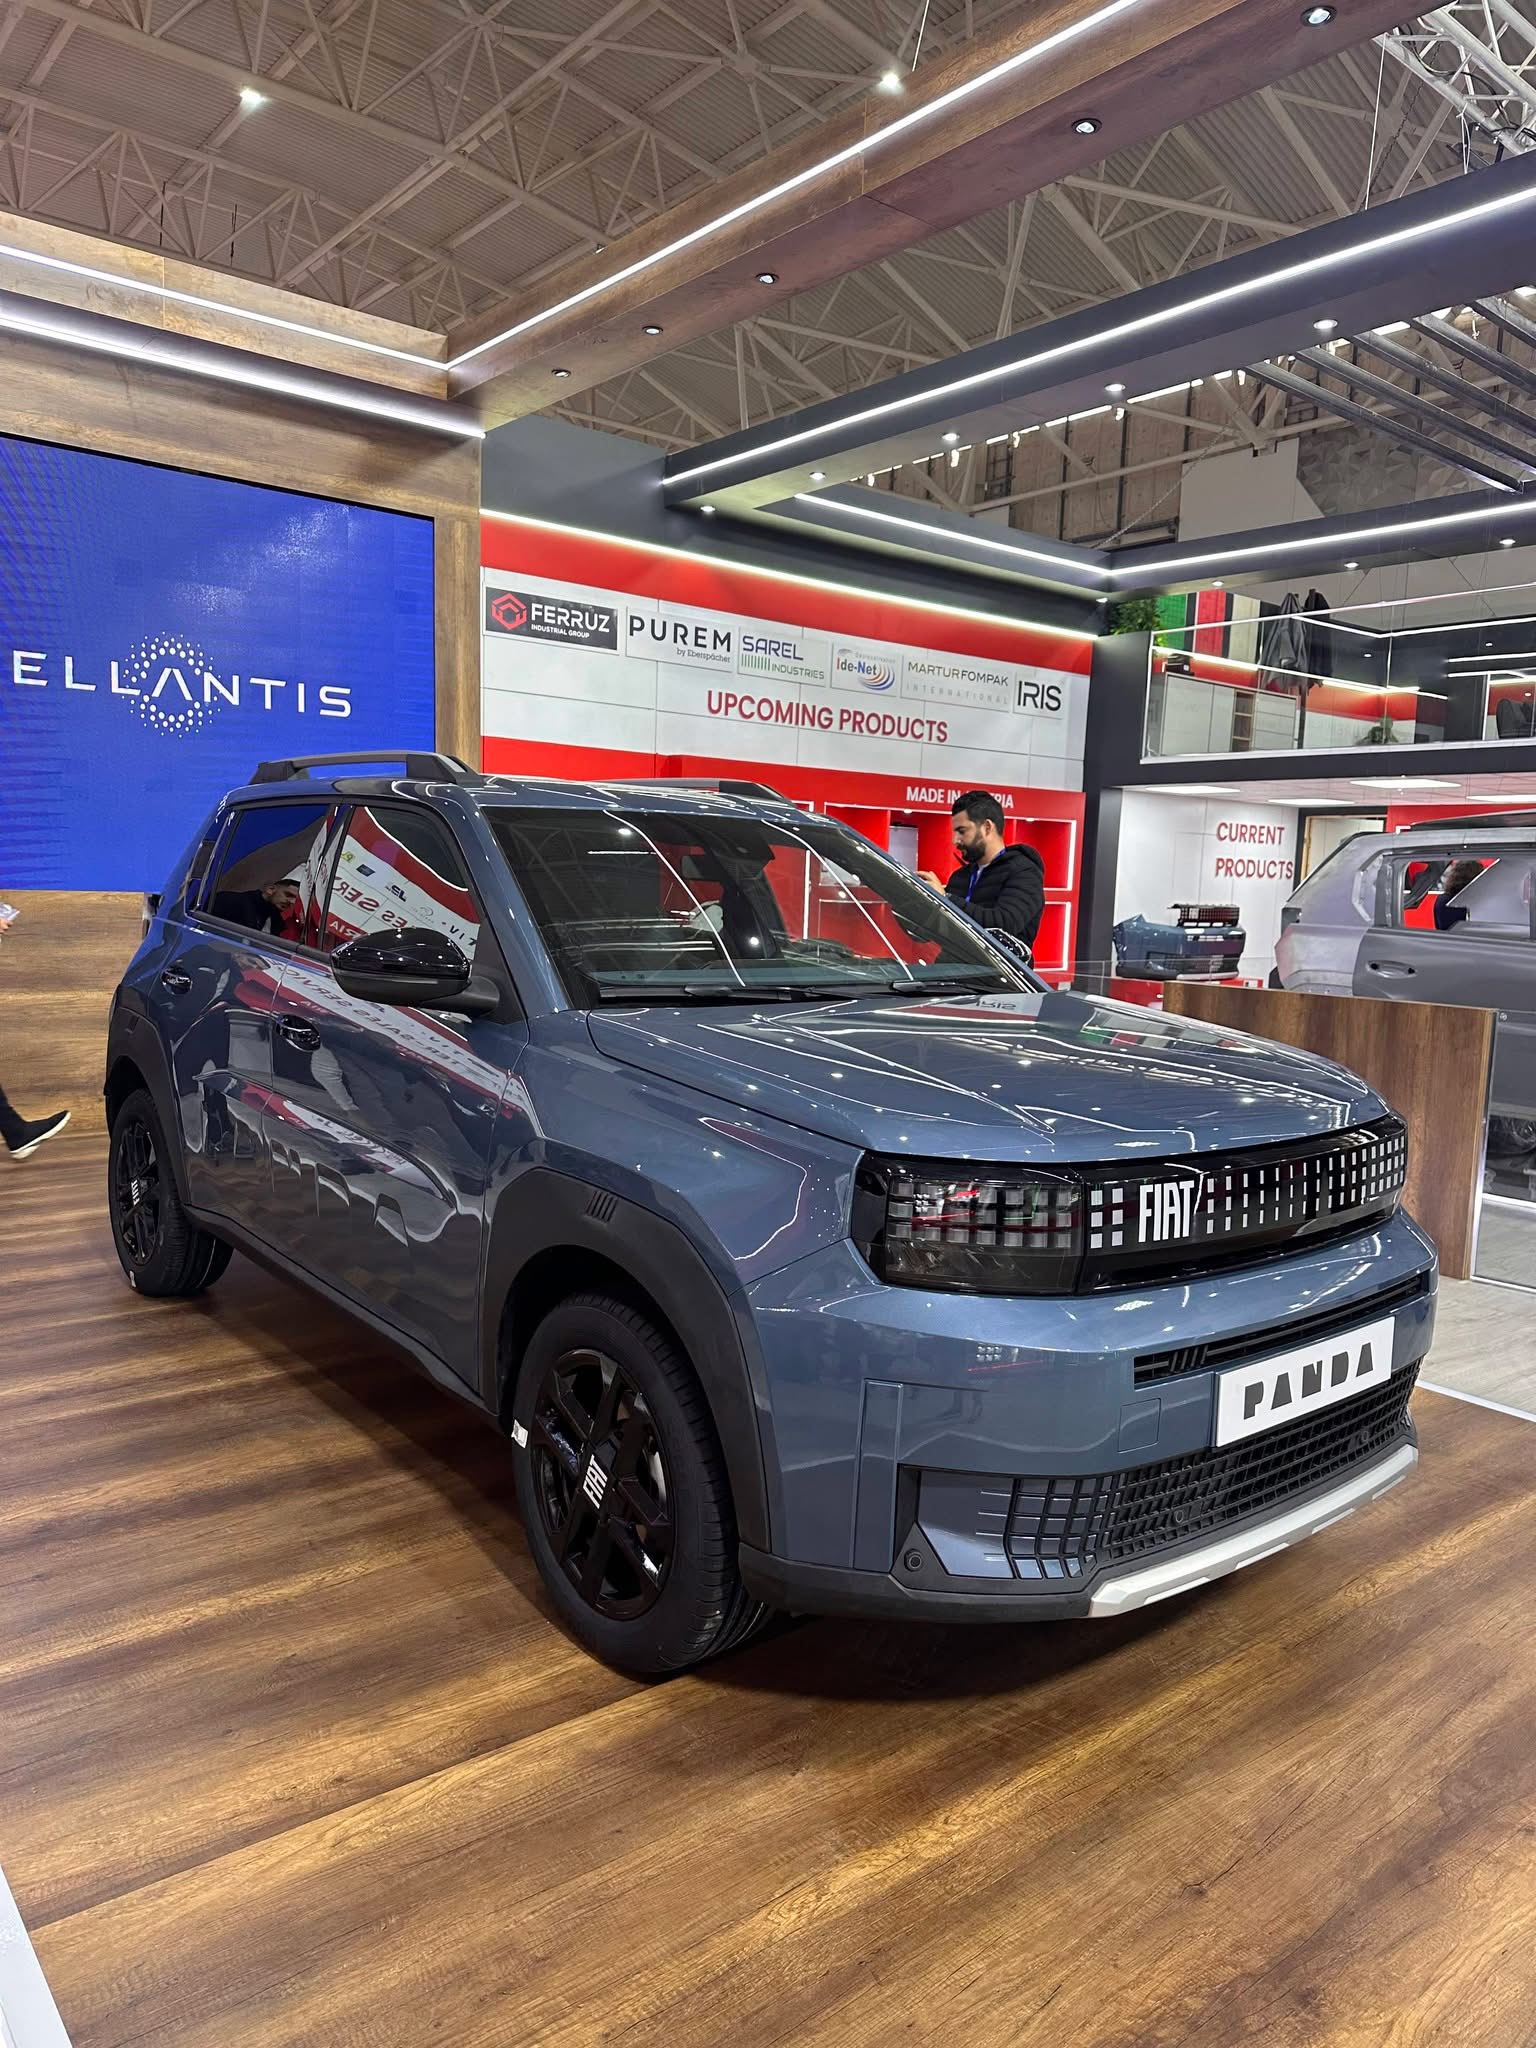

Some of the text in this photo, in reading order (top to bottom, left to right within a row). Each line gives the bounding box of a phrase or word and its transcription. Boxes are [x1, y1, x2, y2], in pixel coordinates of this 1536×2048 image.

[531, 602, 610, 633] FERRUZ
[531, 624, 590, 639] INDUSTRIAL GROUP
[629, 615, 732, 653] PUREM
[677, 648, 686, 657] by
[742, 635, 804, 661] SAREL
[772, 663, 825, 680] INDUSTRIES
[837, 657, 878, 676] Ide-Net
[1017, 680, 1062, 711] IRIS
[707, 690, 948, 743] UPCOMING PRODUCTS
[906, 786, 945, 804] MADE
[1216, 822, 1285, 846] CURRENT
[1214, 857, 1293, 880] PRODUCTS
[1138, 1180, 1195, 1243] FIAT
[1243, 1342, 1374, 1421] PANDA
[582, 1454, 608, 1510] FIAT
